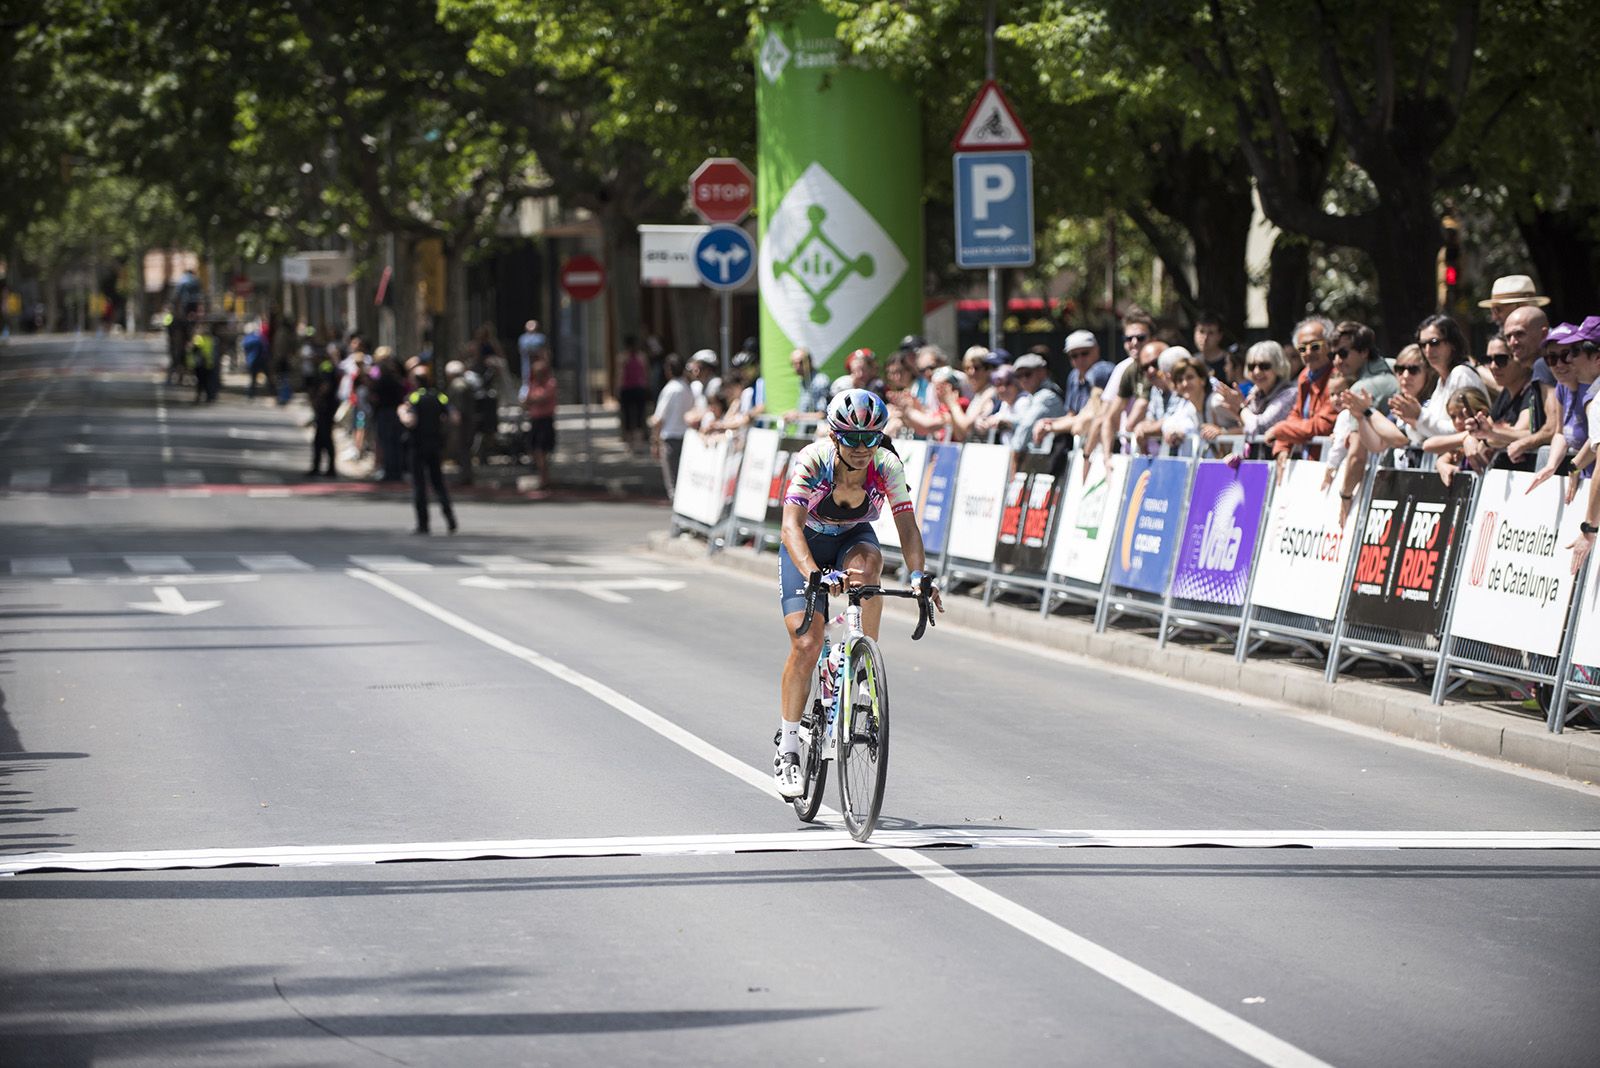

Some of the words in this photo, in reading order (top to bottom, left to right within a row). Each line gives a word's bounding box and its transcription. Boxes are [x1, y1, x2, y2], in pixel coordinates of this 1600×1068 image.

[698, 183, 751, 202] STOP
[971, 163, 1016, 219] P
[1363, 509, 1392, 545] PRO
[1406, 511, 1440, 549] PRO
[1497, 519, 1559, 558] Generalitat
[1355, 545, 1390, 584] RIDE
[1398, 549, 1439, 589] RIDE
[1488, 560, 1502, 591] de
[1503, 562, 1560, 608] Catalunya
